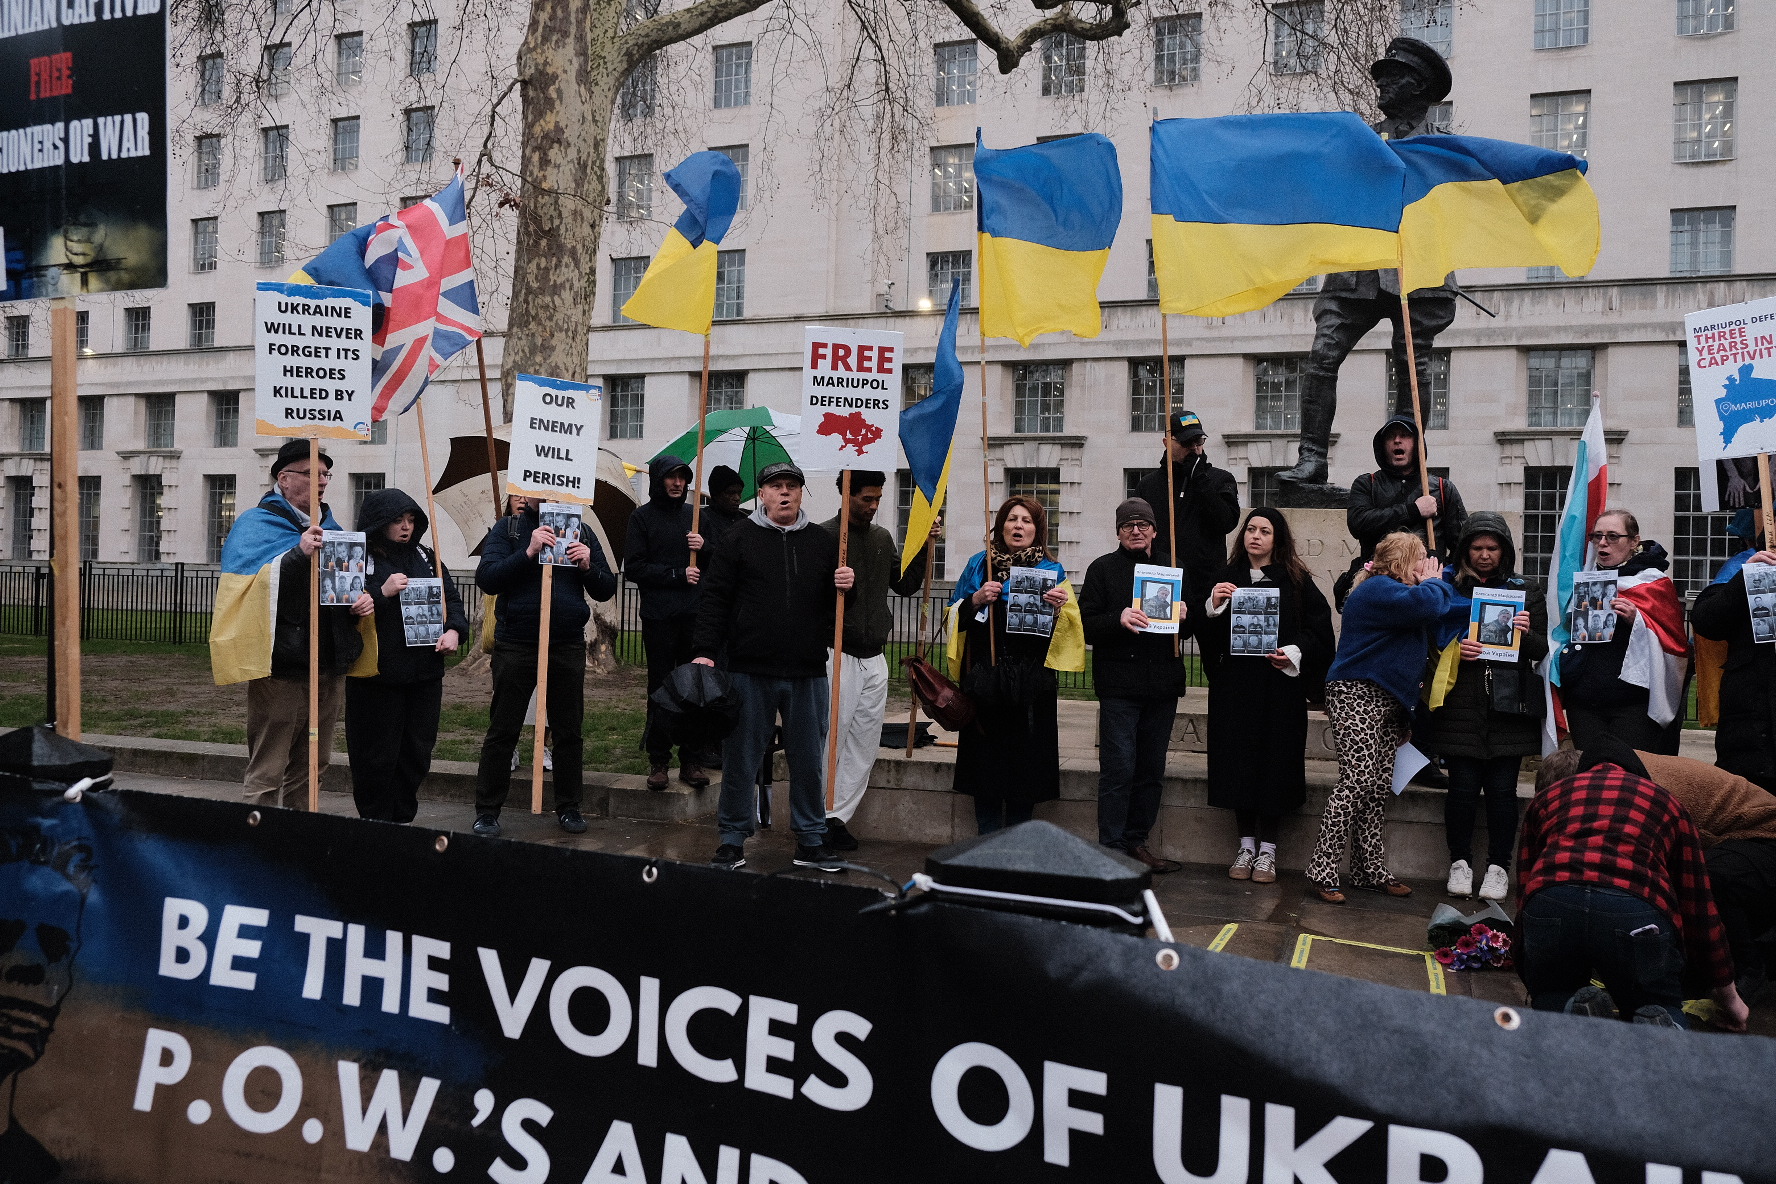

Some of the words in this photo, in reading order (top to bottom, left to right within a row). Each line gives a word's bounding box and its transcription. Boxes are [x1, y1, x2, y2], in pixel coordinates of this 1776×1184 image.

[0, 0, 58, 38] INIAN
[29, 52, 73, 100] FREE
[0, 121, 65, 173] IONERS
[69, 118, 94, 164] OF
[97, 111, 150, 160] WAR
[277, 301, 352, 319] UKRAINE
[264, 321, 306, 337] WILL
[311, 324, 364, 341] NEVER
[1693, 318, 1748, 334] MARIUPOL
[1751, 312, 1776, 324] DEFE
[1694, 326, 1747, 346] THREE
[1695, 338, 1749, 357] YEARS
[1754, 333, 1774, 347] IN
[268, 342, 332, 359] FORGET
[336, 347, 360, 361] ITS
[810, 341, 895, 375] FREE
[1696, 345, 1776, 369] CAPTIVIT
[282, 364, 346, 381] HEROES
[812, 375, 889, 391] MARIUPOL
[273, 385, 329, 400] KILLED
[334, 389, 356, 402] BY
[541, 392, 576, 410] OUR
[809, 394, 890, 410] DEFENDERS
[284, 407, 344, 423] RUSSIA
[529, 416, 584, 437] ENEMY
[534, 443, 573, 462] WILL
[522, 469, 581, 490] PERISH!
[158, 896, 270, 991] BE
[294, 914, 451, 1025] THE
[476, 946, 874, 1112] VOICES
[930, 1041, 1108, 1168] OF
[1152, 1082, 1746, 1184] UKR
